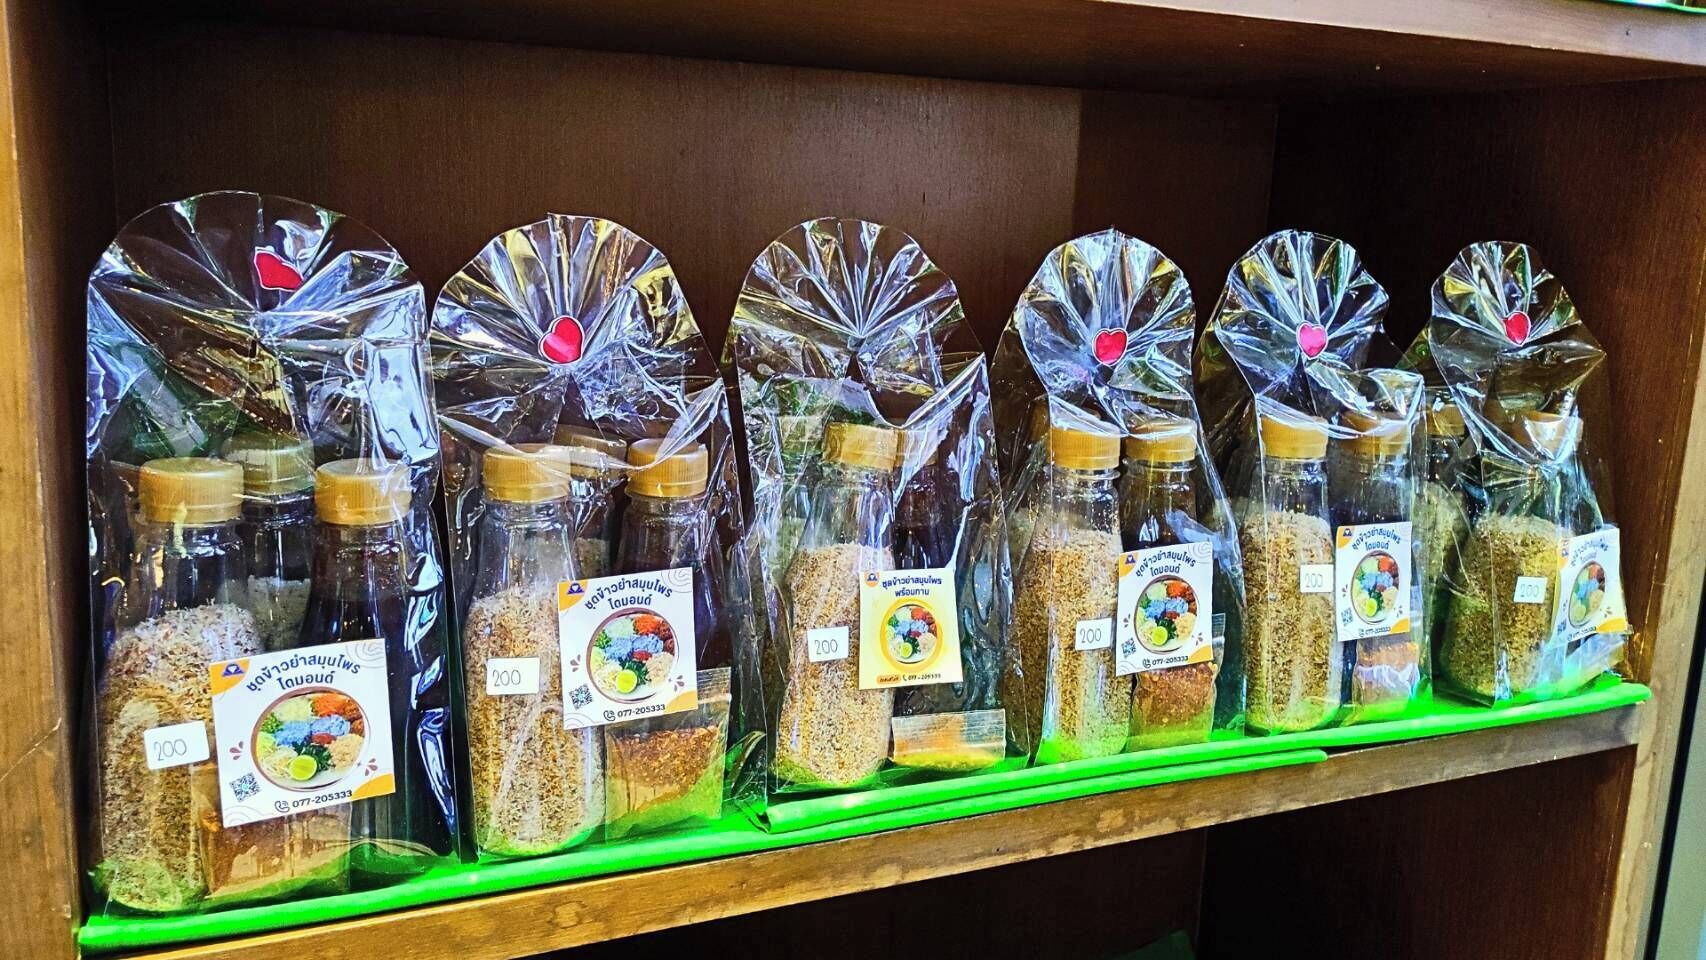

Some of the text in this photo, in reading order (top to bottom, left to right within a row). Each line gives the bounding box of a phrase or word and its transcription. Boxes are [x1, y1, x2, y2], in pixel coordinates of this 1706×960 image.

[584, 577, 673, 610] ชุดข้าวยำสมุนไพร
[1079, 628, 1102, 644] 200
[814, 638, 839, 655] 200
[246, 653, 361, 692] ชุดข้าวยำสมุนไพร
[492, 669, 521, 687] 200
[617, 703, 666, 718] 077-205333
[153, 738, 187, 762] 200
[292, 790, 353, 808] 077-205333
